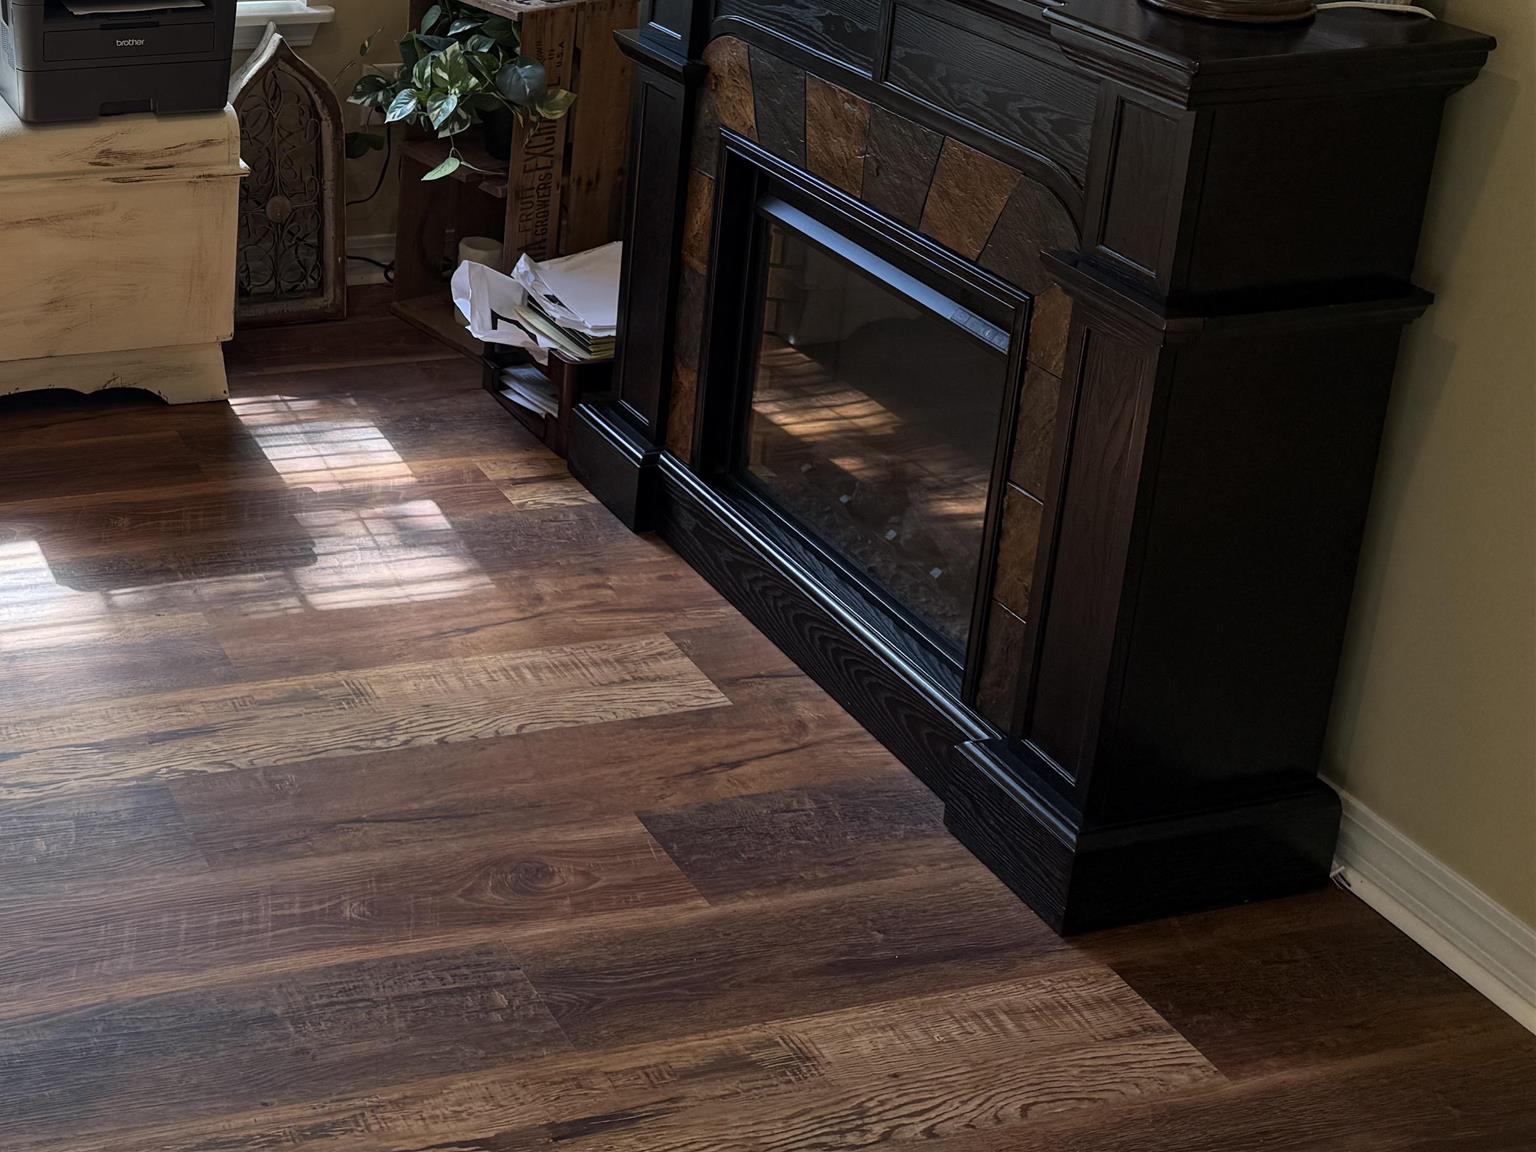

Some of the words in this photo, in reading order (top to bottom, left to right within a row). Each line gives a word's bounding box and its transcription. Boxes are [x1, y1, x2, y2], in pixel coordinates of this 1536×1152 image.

[116, 38, 144, 47] brother
[517, 185, 535, 233] FRUIT
[534, 173, 553, 236] GROWERS
